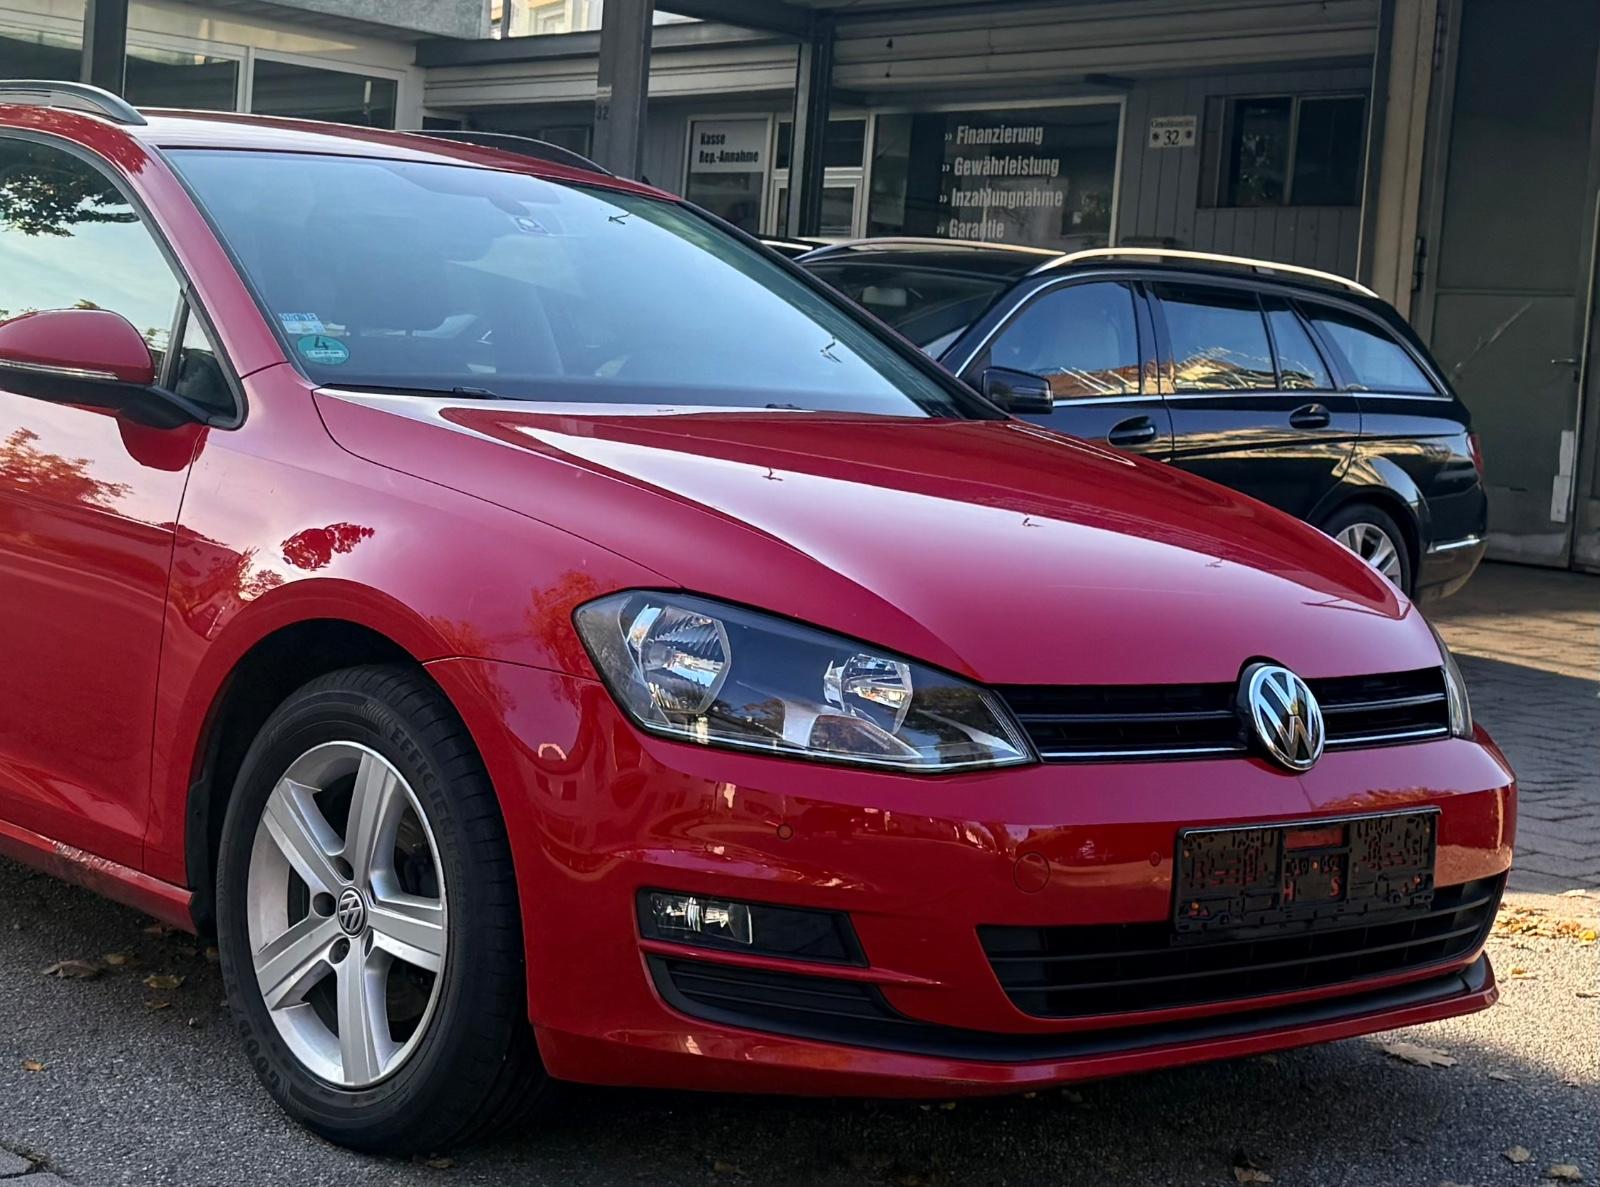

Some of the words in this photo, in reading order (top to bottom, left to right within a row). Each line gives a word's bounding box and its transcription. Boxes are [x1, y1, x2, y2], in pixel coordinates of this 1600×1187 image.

[700, 132, 726, 146] Kasse
[957, 125, 1044, 145] Finanzierung
[1163, 129, 1180, 146] 32
[699, 149, 760, 165] Rep.-Annahme
[954, 155, 1060, 178] Gewährleistung
[951, 187, 1063, 210] Inzahlungnahme
[948, 218, 1005, 239] Garantie
[314, 335, 329, 351] 4
